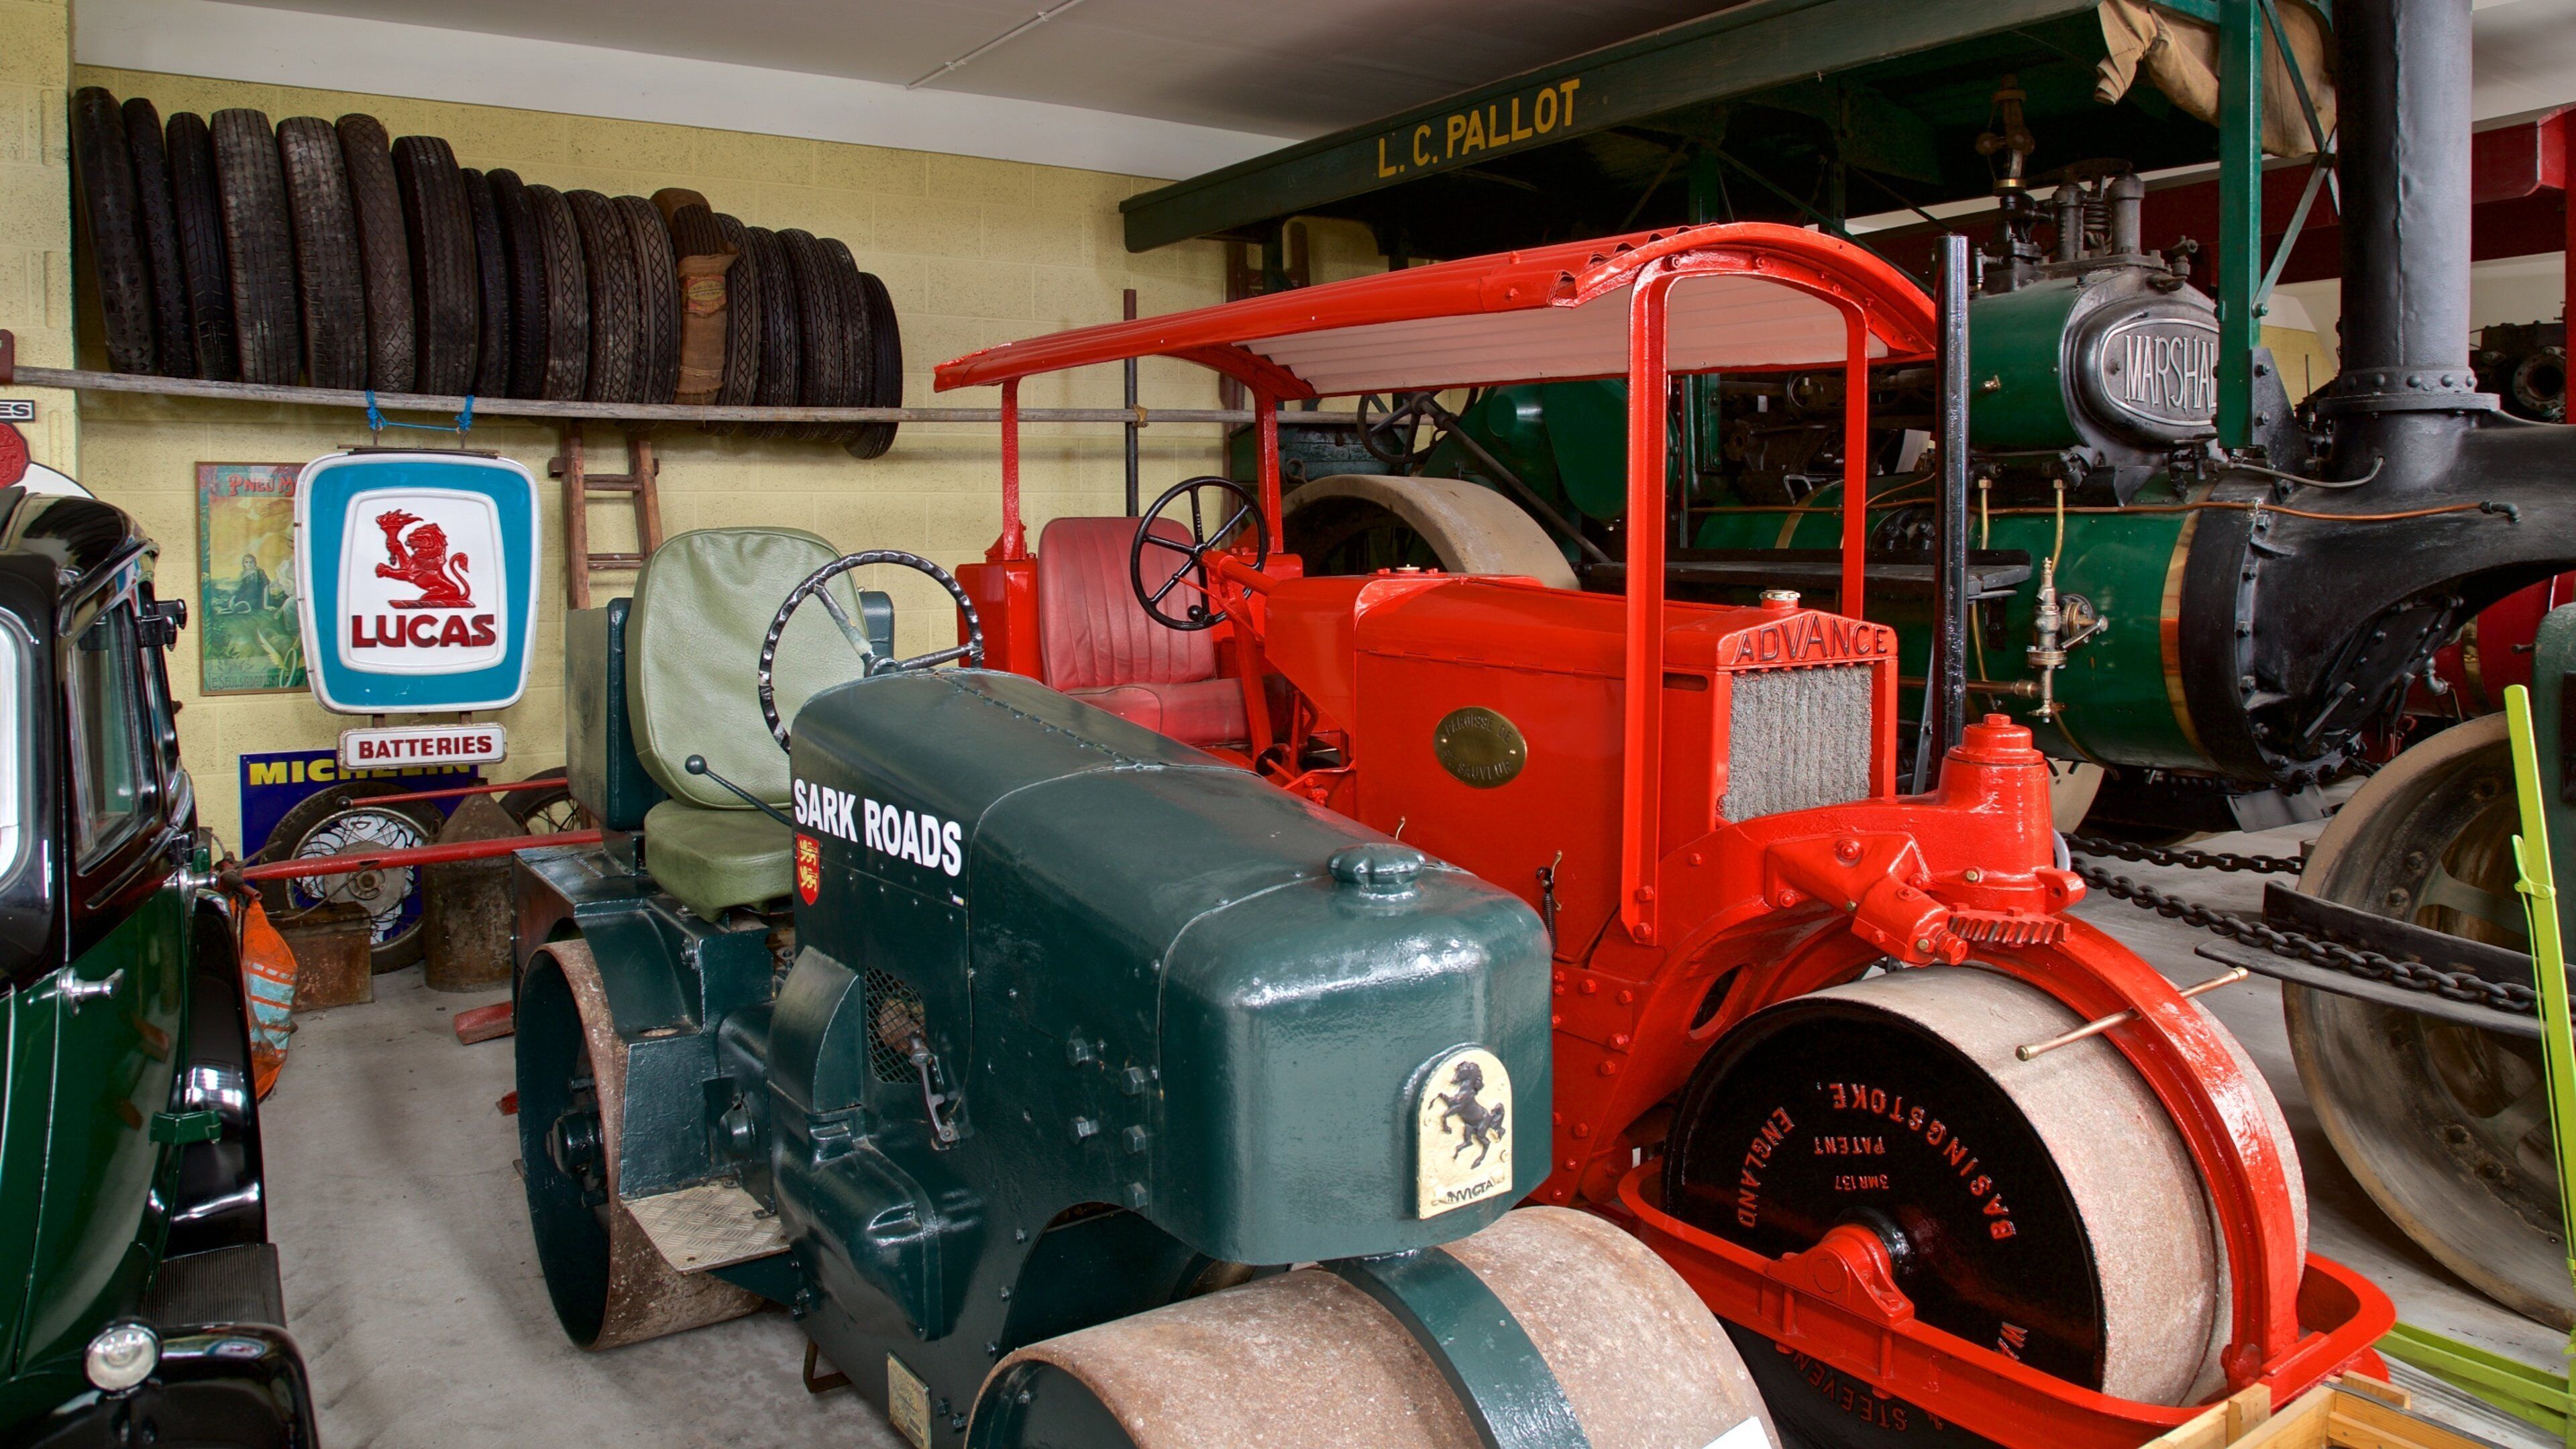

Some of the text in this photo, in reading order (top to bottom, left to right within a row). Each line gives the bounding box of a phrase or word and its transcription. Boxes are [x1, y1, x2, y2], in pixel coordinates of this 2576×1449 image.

[1378, 78, 1580, 178] L. C. PALLOT
[2125, 335, 2217, 413] MARSHAL
[227, 474, 275, 496] PNEU
[352, 614, 496, 648] LUCAS
[1734, 614, 1888, 661] ADVANCE
[358, 735, 492, 759] BATTERIES
[1445, 713, 1513, 745] PAROISSE DE
[794, 778, 962, 877] SARK ROADS
[1737, 1106, 1795, 1228] ENGLAND
[1813, 1136, 1886, 1155] PATENT
[1793, 1351, 1908, 1432] STEEVEN
